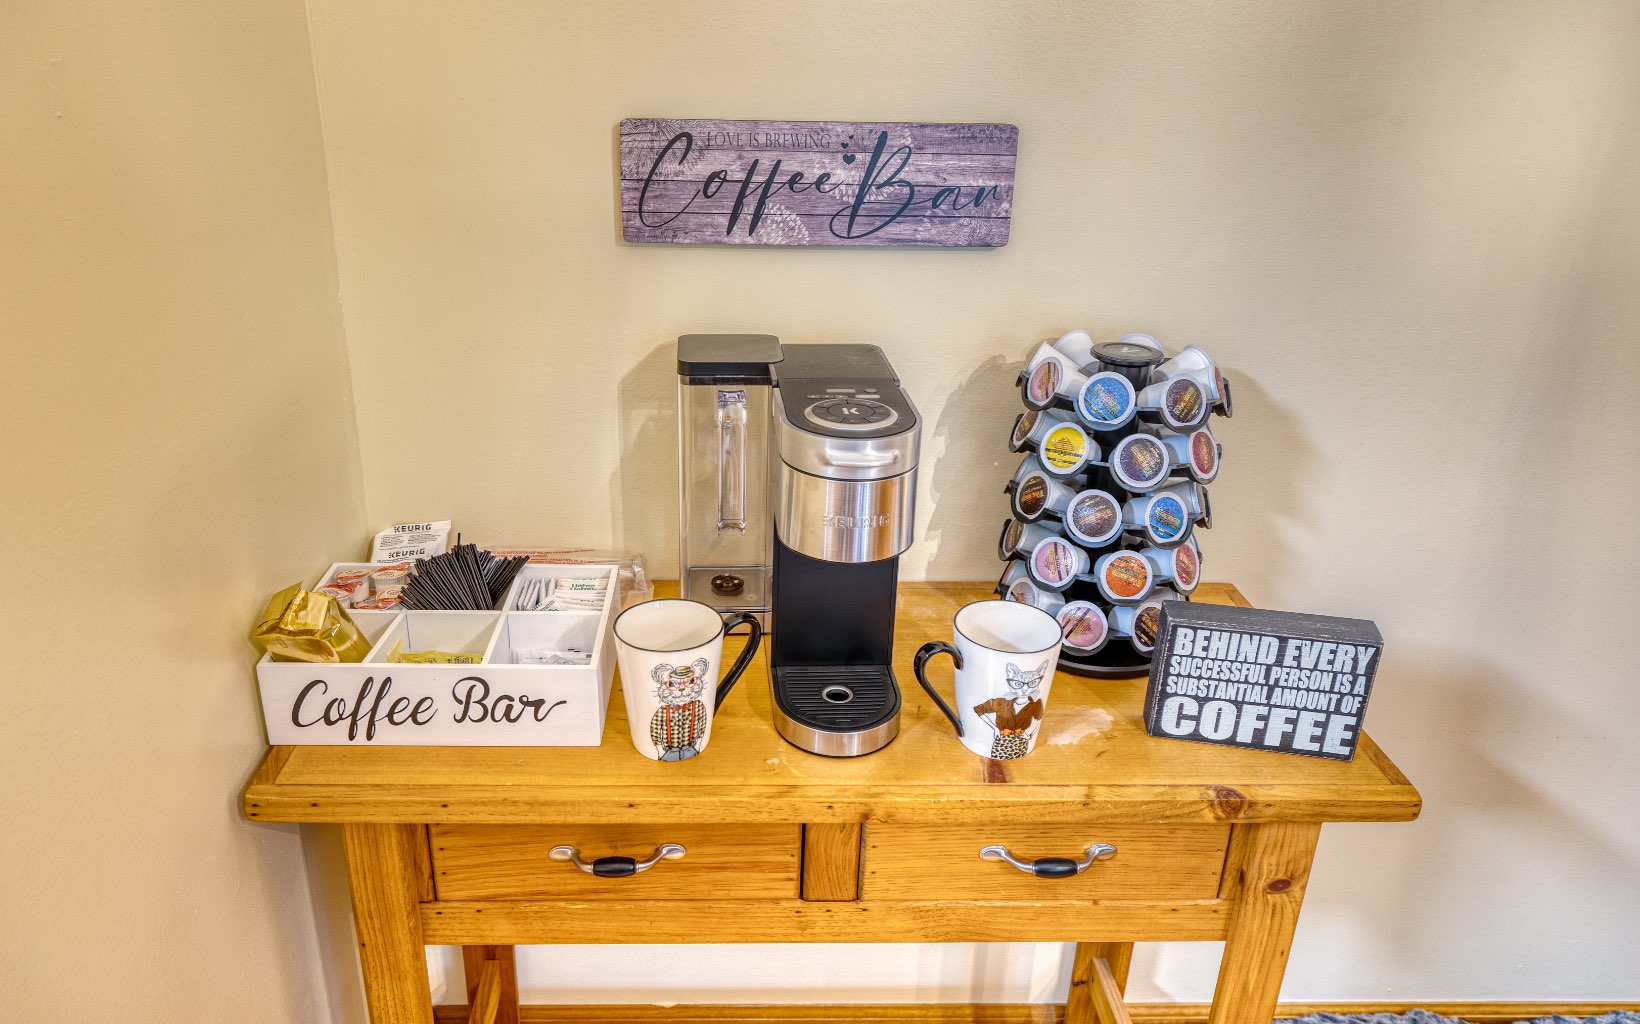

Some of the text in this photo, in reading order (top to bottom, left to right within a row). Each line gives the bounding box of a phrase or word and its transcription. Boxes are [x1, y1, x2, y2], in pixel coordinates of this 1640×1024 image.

[707, 132, 832, 149] LOVE IS BREWING
[638, 130, 999, 239] Coffee Bar
[394, 524, 432, 533] KEURIG
[823, 513, 890, 528] KEURIG
[389, 548, 426, 559] KEURIG
[1175, 627, 1280, 666] BEHIND
[1283, 638, 1377, 675] EVERY
[1166, 676, 1364, 714] SUBSTANTIAL AMOUNT OF
[1169, 655, 1367, 696] SUCCESSFUL PERSON IS A
[290, 676, 568, 742] Coffee Bar
[1161, 695, 1358, 756] COFFEE
